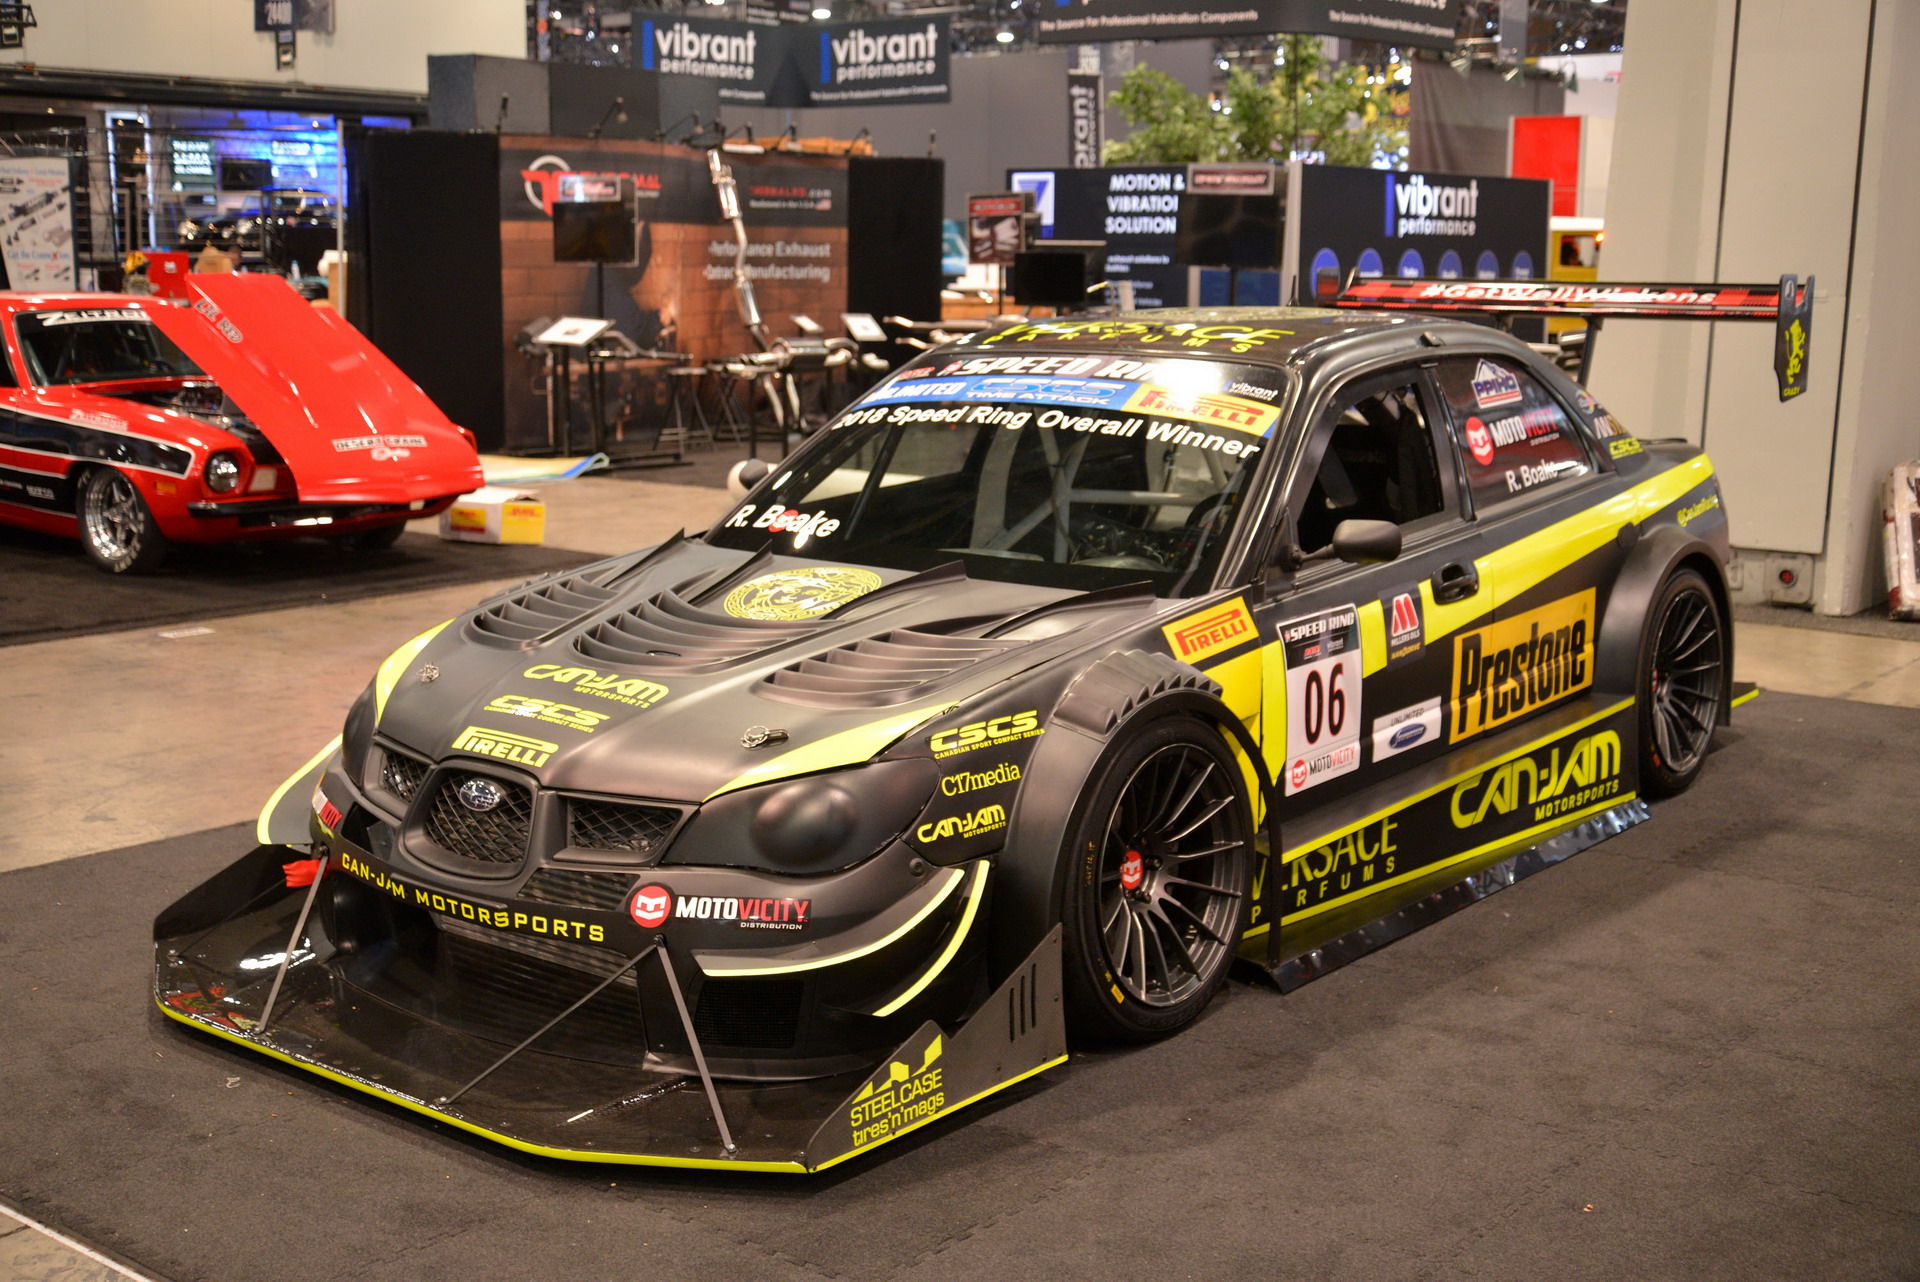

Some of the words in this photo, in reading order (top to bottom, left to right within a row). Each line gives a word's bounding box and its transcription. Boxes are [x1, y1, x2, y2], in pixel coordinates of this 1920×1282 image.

[1200, 9, 1258, 24] Components
[655, 22, 757, 65] vibrant
[832, 22, 938, 65] vibrant
[660, 57, 755, 81] performance
[836, 59, 936, 85] performance
[1110, 174, 1172, 192] MOTION
[1174, 172, 1186, 191] &
[1395, 174, 1478, 218] vibrant
[1397, 216, 1476, 238] performance
[775, 240, 831, 257] Exhaust
[953, 356, 1102, 376] SPEED
[966, 391, 1020, 400] TIME
[1017, 391, 1110, 406] ATTACK
[970, 377, 1126, 399] CSCS
[1230, 381, 1278, 398] vibrant
[831, 406, 889, 430] 2018
[886, 405, 971, 427] Speed
[966, 406, 1033, 430] Ring
[1036, 409, 1144, 438] Overall
[1145, 420, 1261, 460] Winner
[1489, 407, 1558, 448] MOTOVICITY
[1504, 469, 1522, 493] R.
[1520, 459, 1559, 488] Boake
[724, 504, 756, 528] R.
[1174, 607, 1248, 657] PIRELLI
[1290, 619, 1327, 643] SPEED
[1327, 611, 1356, 631] RING
[1391, 634, 1410, 647] MILLERS
[1409, 630, 1421, 642] OILS
[523, 664, 669, 704] CAN-JAM
[1458, 619, 1586, 735] Prestone
[489, 694, 611, 726] CSCS
[573, 685, 650, 709] MOTORSPORTS
[1304, 661, 1346, 745] 06
[930, 710, 1038, 752] CSCS
[1390, 707, 1425, 727] UNLIMITED
[451, 725, 560, 768] PIRELLI
[934, 745, 971, 760] CANADIAN
[971, 741, 992, 752] SPORT
[993, 733, 1022, 746] COMPACT
[1023, 728, 1046, 738] SERIES
[1308, 746, 1355, 776] MOTOVICITY
[941, 762, 1022, 797] C17media
[1451, 729, 1621, 829] CAN-JAM
[1535, 778, 1619, 822] MOTORSPORTS
[917, 804, 1006, 843] CAN-JAM
[963, 821, 1007, 839] MOTORSPORTS
[1251, 817, 1398, 901] VRSACE
[341, 852, 405, 899] CAN-JAM
[415, 888, 605, 943] MOTORSPORTS
[1251, 855, 1396, 925] PRFUMS
[675, 896, 808, 923] MOTOVICITY
[740, 921, 803, 931] DISTRIBUTION
[851, 1068, 943, 1128] STEELCASE
